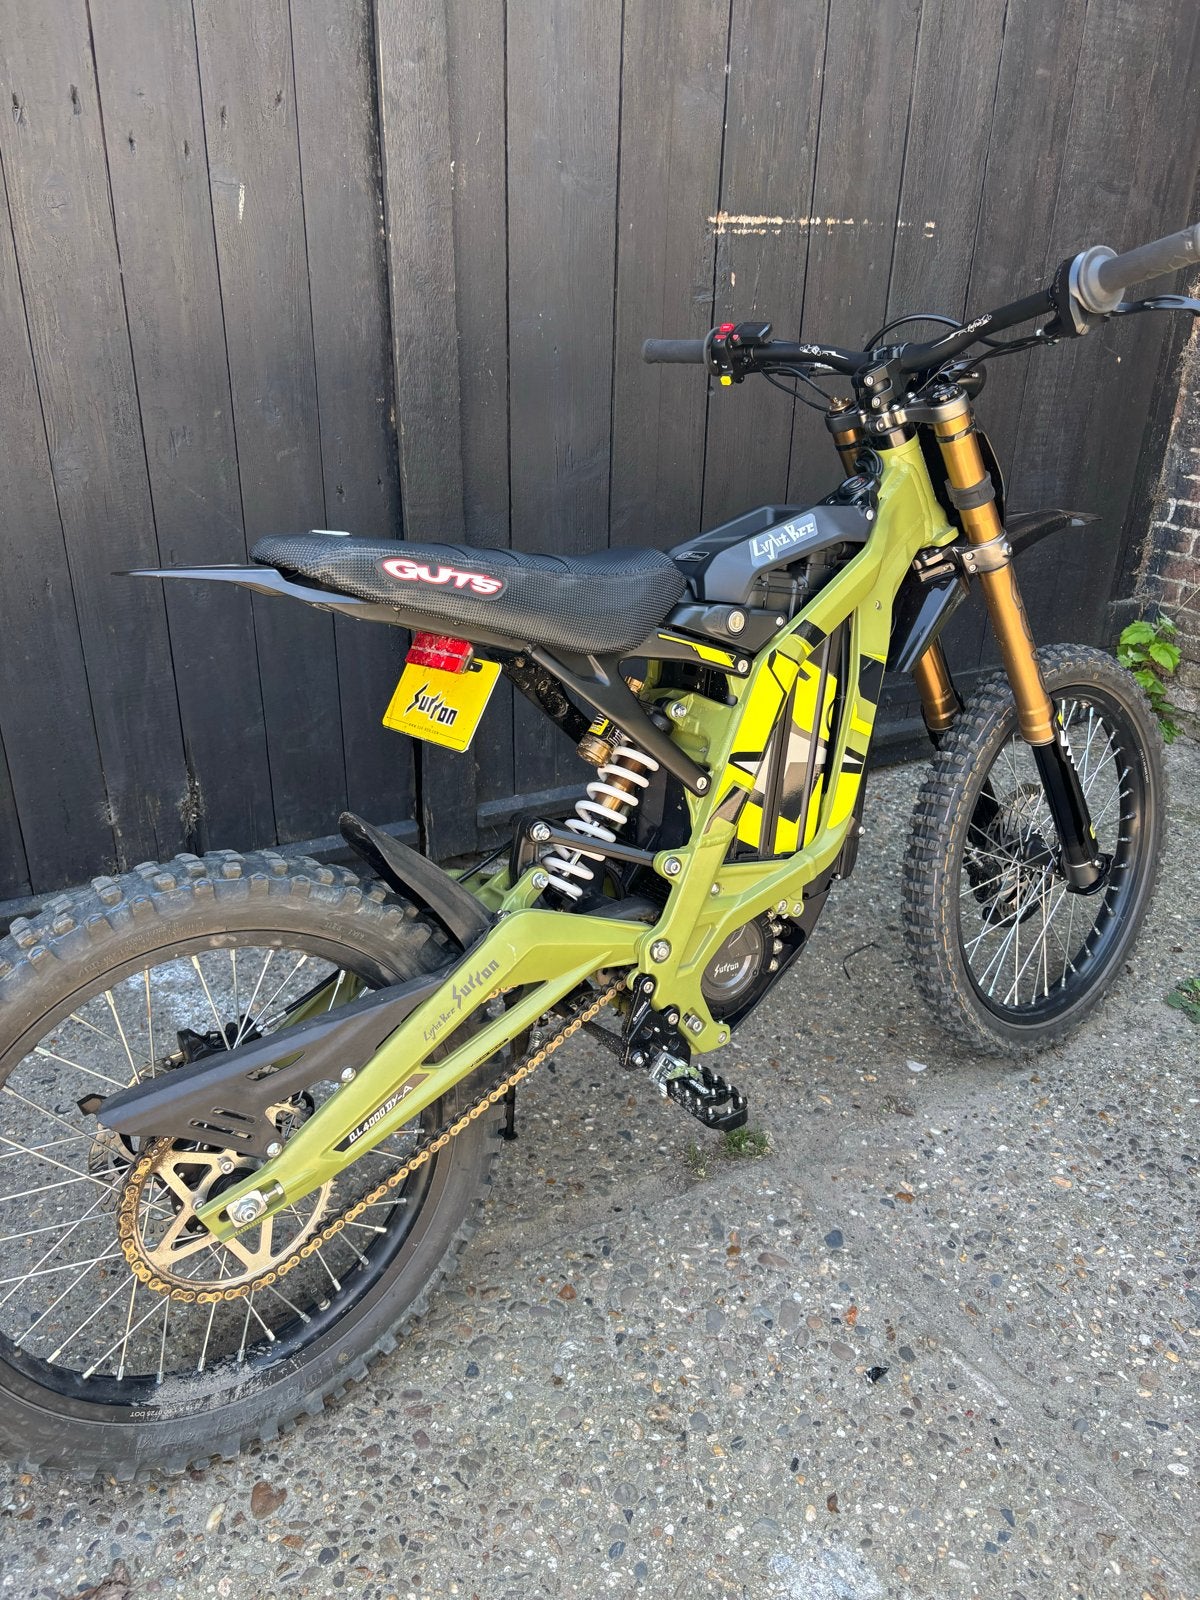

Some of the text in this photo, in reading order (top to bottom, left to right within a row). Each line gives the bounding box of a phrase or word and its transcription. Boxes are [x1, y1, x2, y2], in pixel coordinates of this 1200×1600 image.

[382, 557, 503, 596] GUTS
[404, 682, 458, 726] Surron
[452, 959, 500, 1010] Surron
[129, 1410, 146, 1418] DOT
